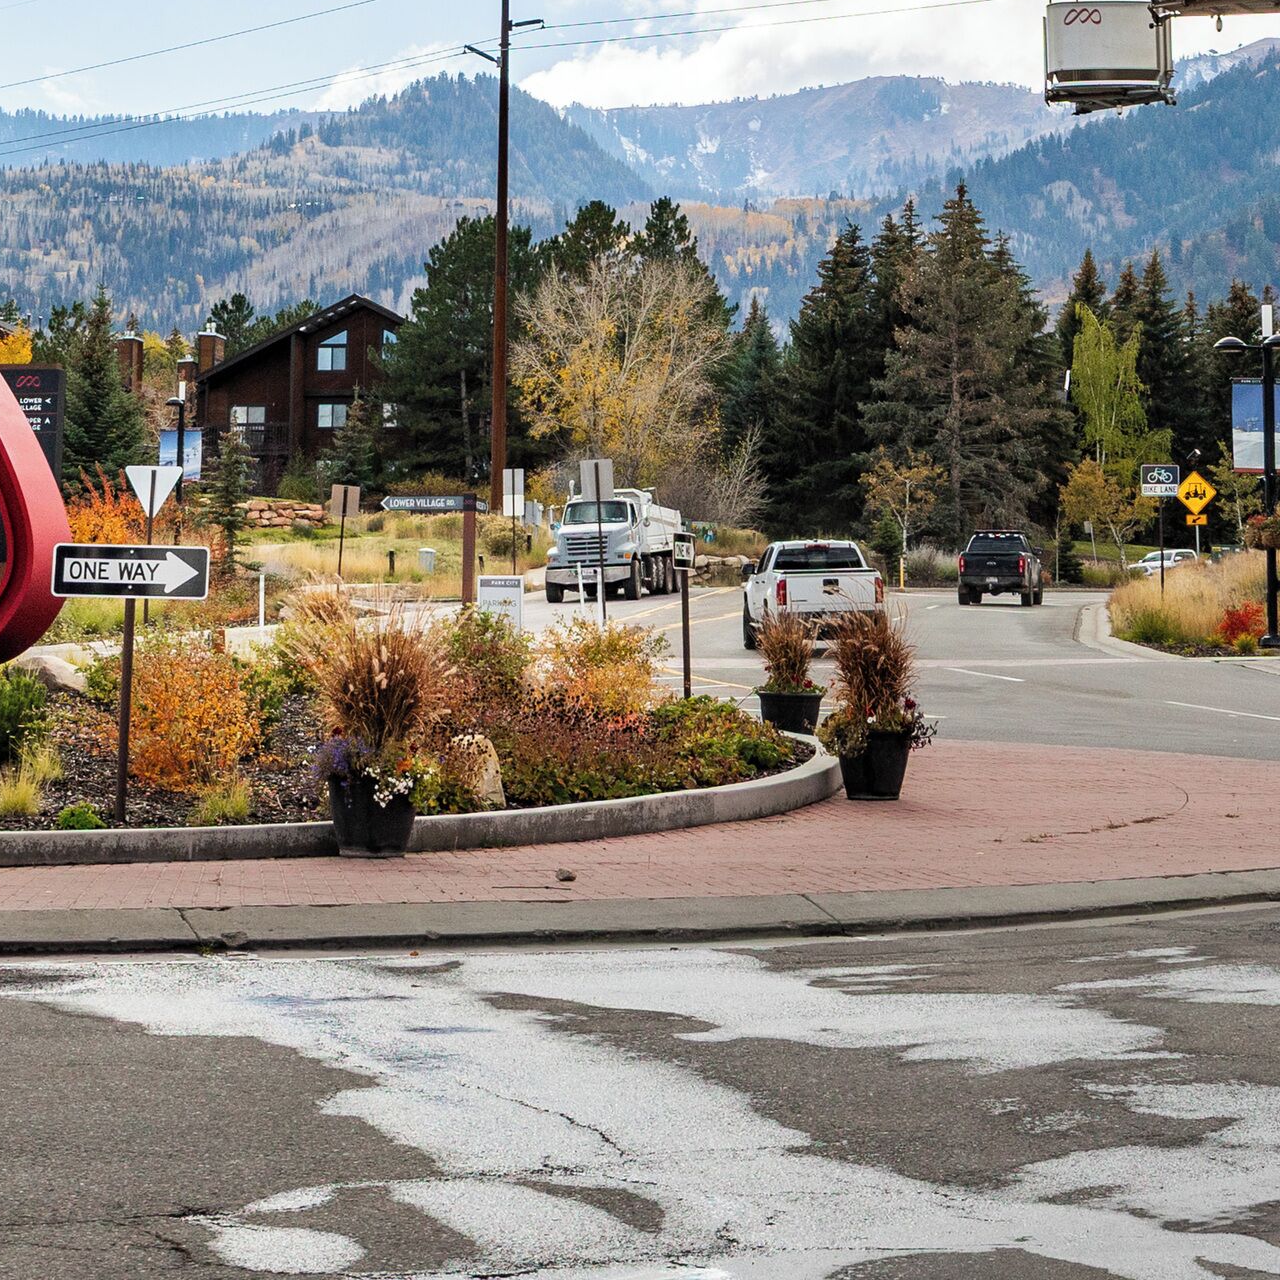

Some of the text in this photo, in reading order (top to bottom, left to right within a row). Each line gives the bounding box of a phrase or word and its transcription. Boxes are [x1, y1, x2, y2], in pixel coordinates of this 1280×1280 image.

[1143, 485, 1177, 494] BIKE LANE
[389, 498, 415, 508] LOWER
[416, 498, 445, 508] VILLAGE
[69, 561, 160, 581] ONE WAY
